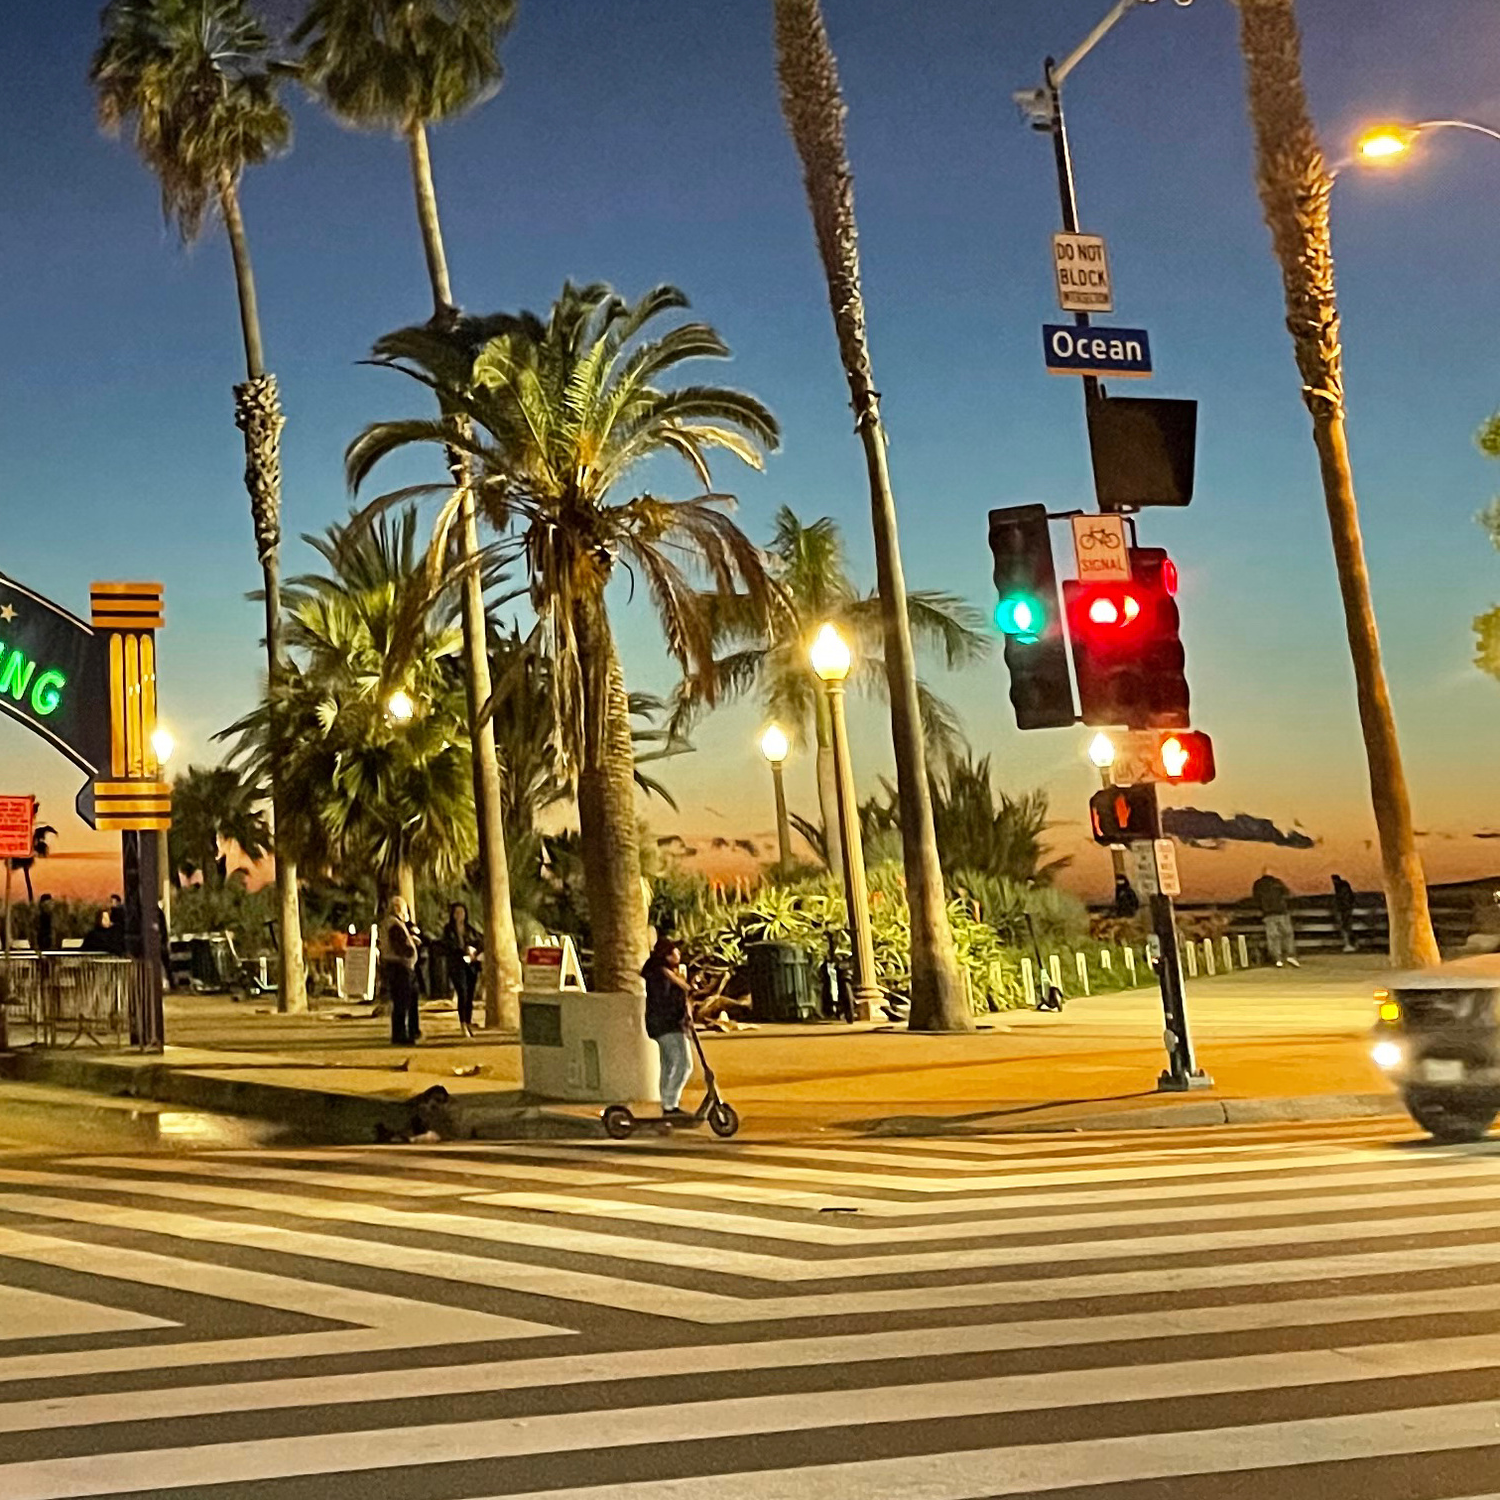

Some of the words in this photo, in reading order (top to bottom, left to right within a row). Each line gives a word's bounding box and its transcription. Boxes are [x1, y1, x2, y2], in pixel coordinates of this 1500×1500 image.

[1056, 243, 1074, 260] DO
[1077, 244, 1102, 261] NOT
[1060, 269, 1106, 286] BLOCK
[1052, 331, 1142, 361] Ocean
[1080, 556, 1125, 572] SIGNAL
